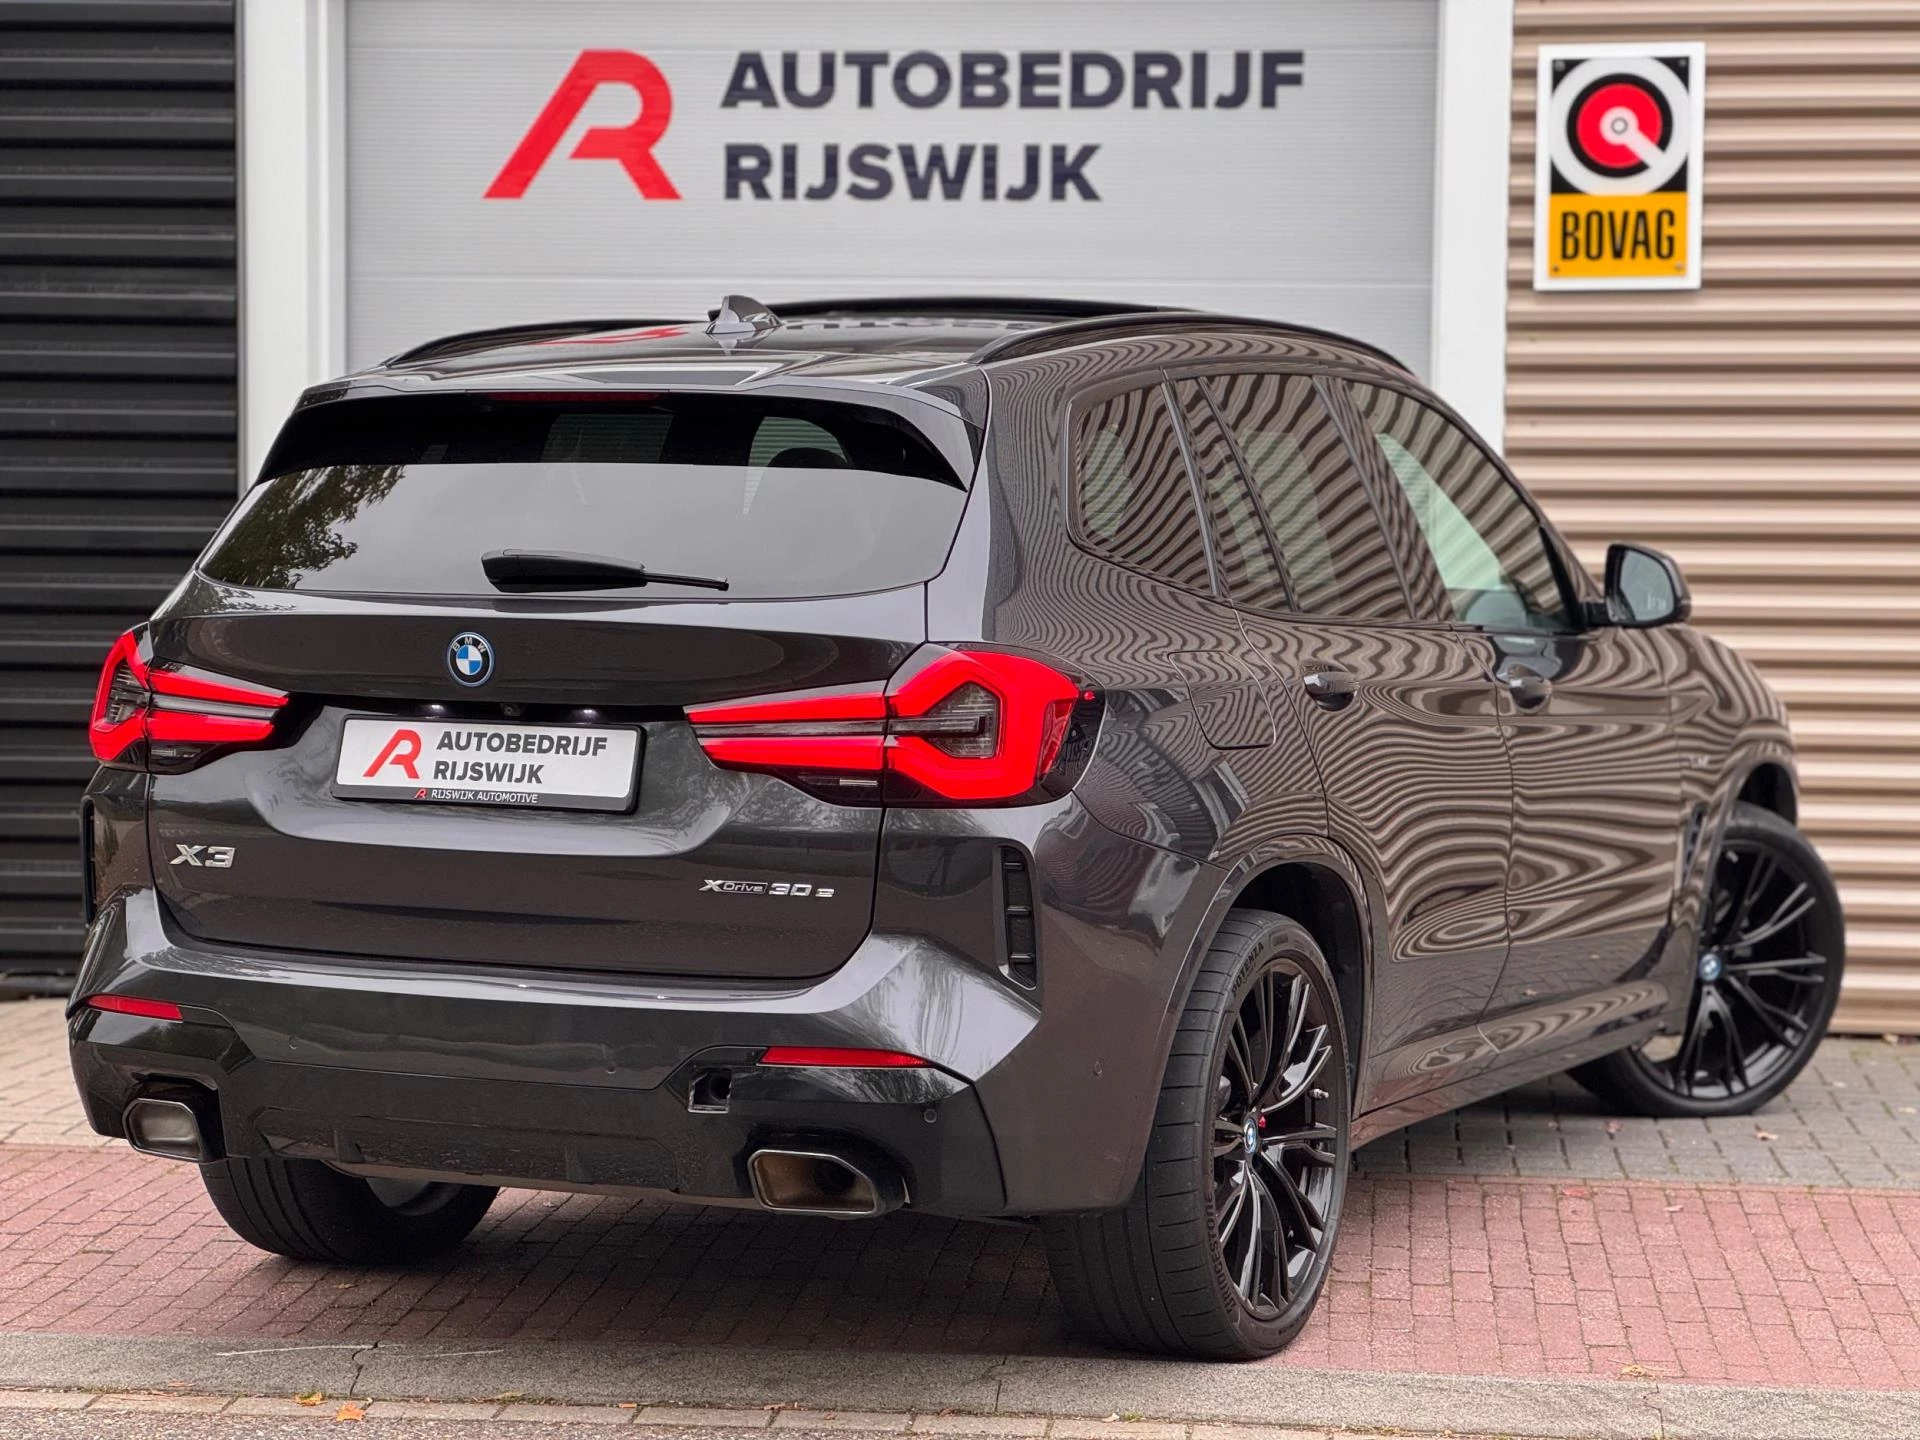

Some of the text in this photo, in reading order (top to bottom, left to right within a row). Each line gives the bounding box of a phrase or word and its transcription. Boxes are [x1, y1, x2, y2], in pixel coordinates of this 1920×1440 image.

[721, 50, 1305, 109] AUTOBEDRIJF
[725, 143, 1102, 202] RIJSWIJK
[1561, 209, 1676, 260] BOVAG
[451, 636, 487, 653] BMW
[436, 731, 608, 756] AUTOBEDRIJF
[433, 761, 543, 784] RIJSWIJK
[431, 789, 475, 801] RIJSWIJK
[476, 793, 539, 804] AUTOMOTIVE
[169, 844, 236, 868] X3
[1231, 941, 1265, 998] POTENZA
[1204, 1191, 1236, 1315] BRIDGESTONE
